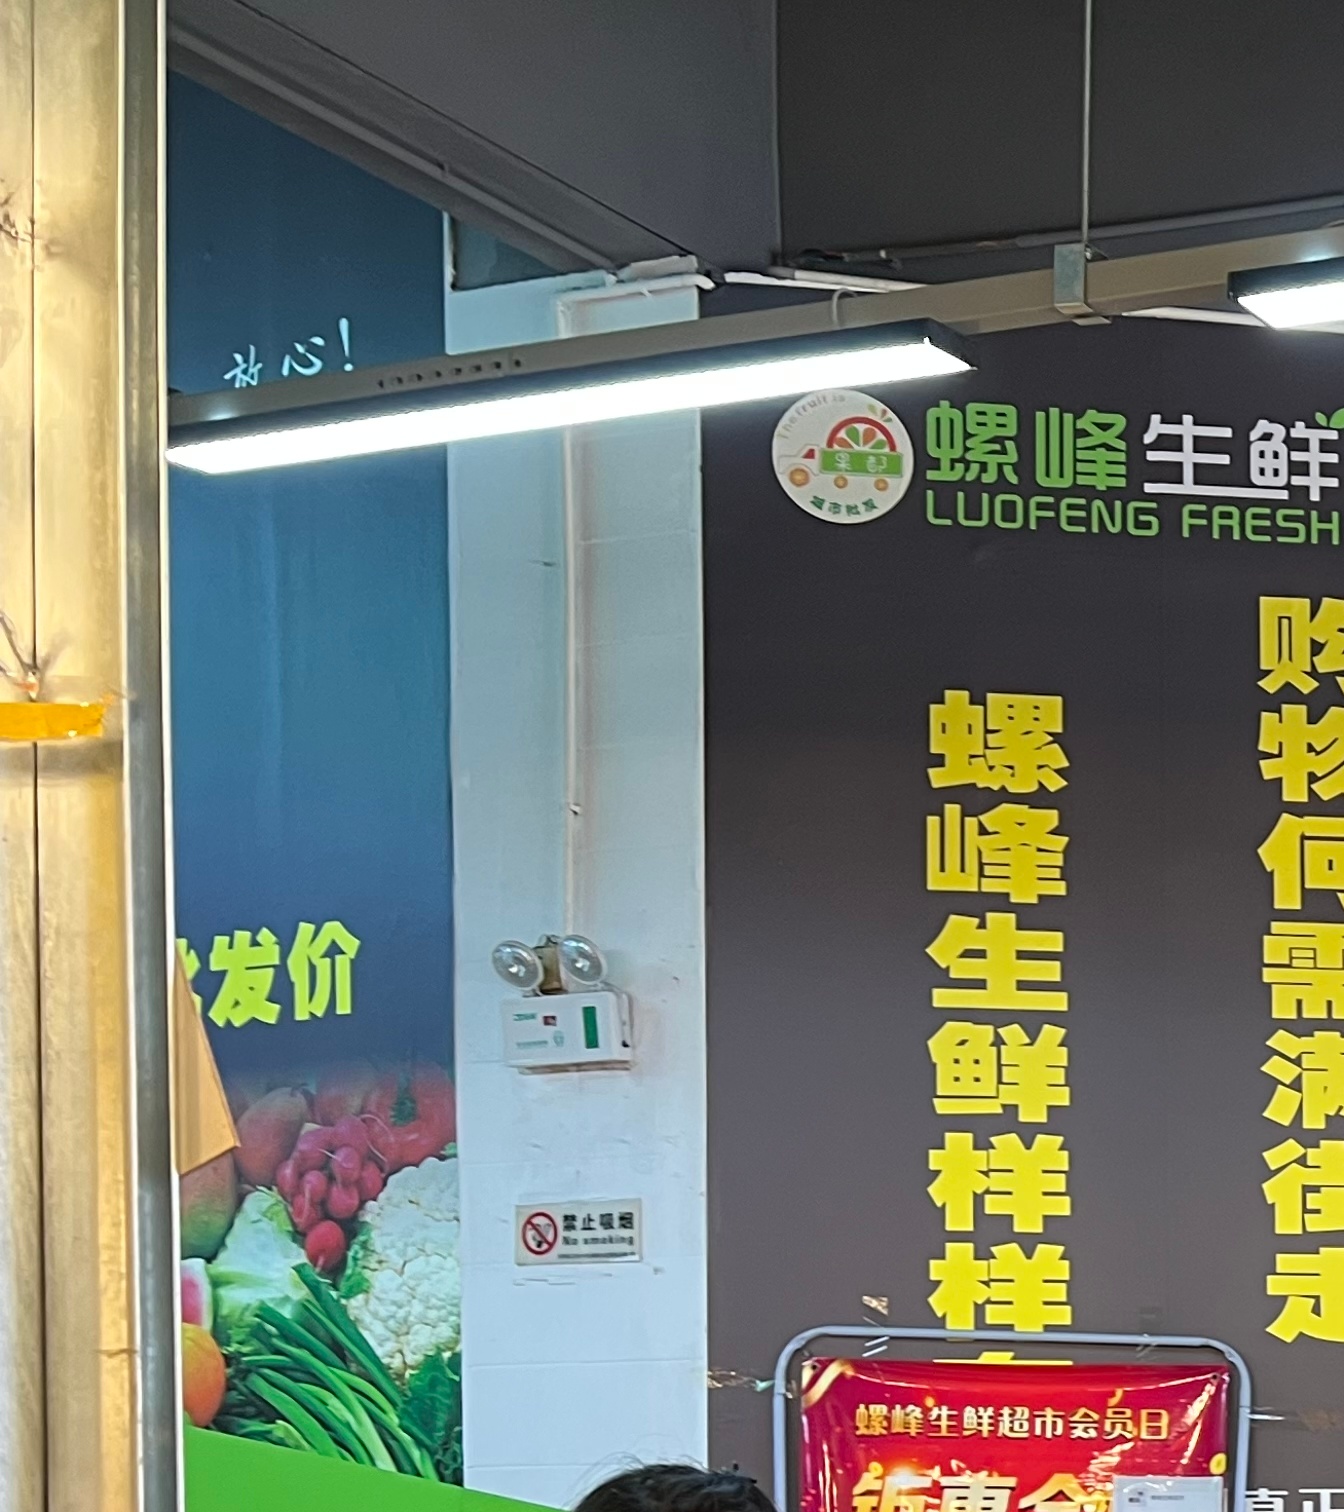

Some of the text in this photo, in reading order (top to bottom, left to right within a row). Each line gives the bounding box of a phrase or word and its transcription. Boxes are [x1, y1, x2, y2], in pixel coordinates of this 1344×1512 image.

[925, 400, 1340, 502] 螺峰生鲜
[925, 490, 1341, 545] LUOFENG FRESH
[176, 920, 361, 1029] 发价
[924, 689, 1072, 1366] 螺峰生鲜样样
[854, 1404, 1170, 1441] 螺峰生鲜超市会员日
